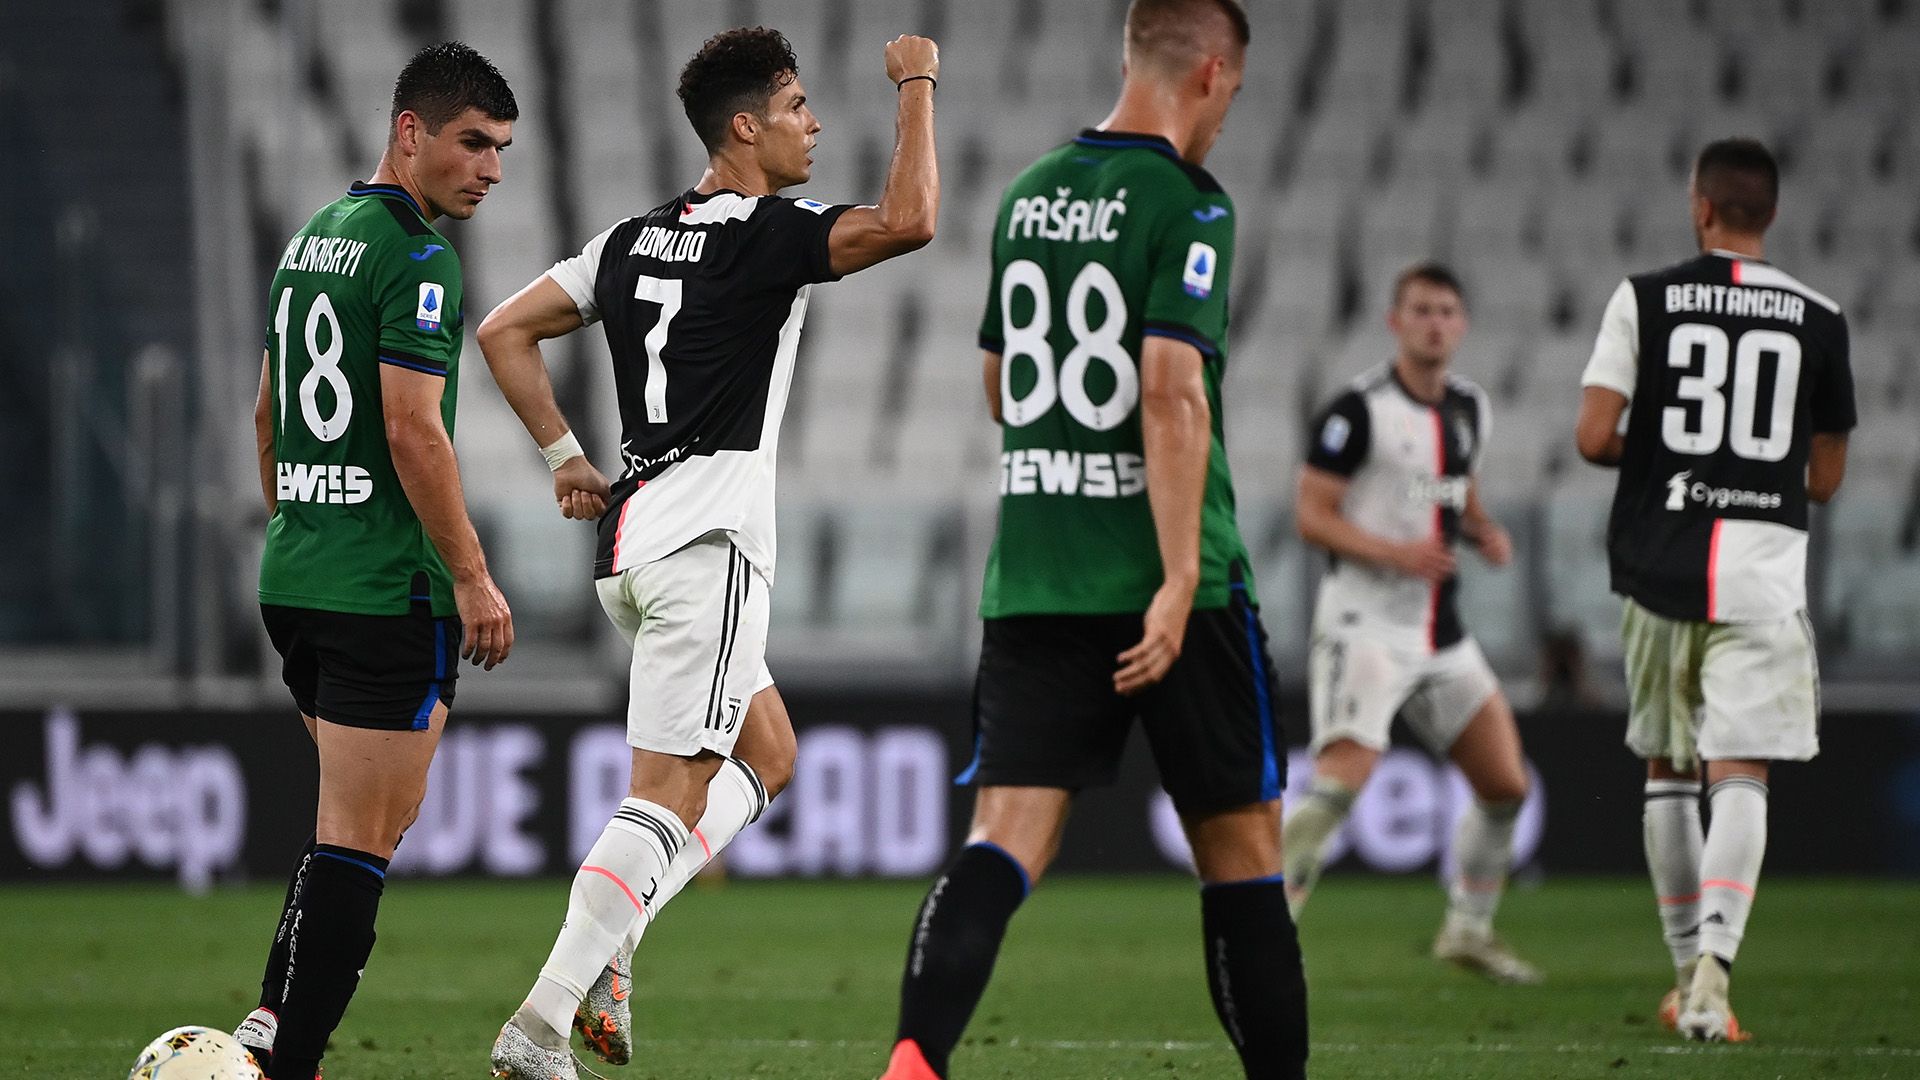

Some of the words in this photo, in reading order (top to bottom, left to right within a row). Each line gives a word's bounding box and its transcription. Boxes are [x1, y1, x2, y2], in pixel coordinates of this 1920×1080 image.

[279, 235, 368, 278] ALINOVSKYI
[1665, 283, 1806, 326] BENTANCUR
[275, 287, 353, 442] 18
[634, 274, 683, 424] 7
[1001, 259, 1140, 431] 88
[1662, 322, 1802, 462] 30
[276, 462, 373, 504] EWISS
[1000, 448, 1146, 498] EWSS
[10, 704, 248, 896] Jeep
